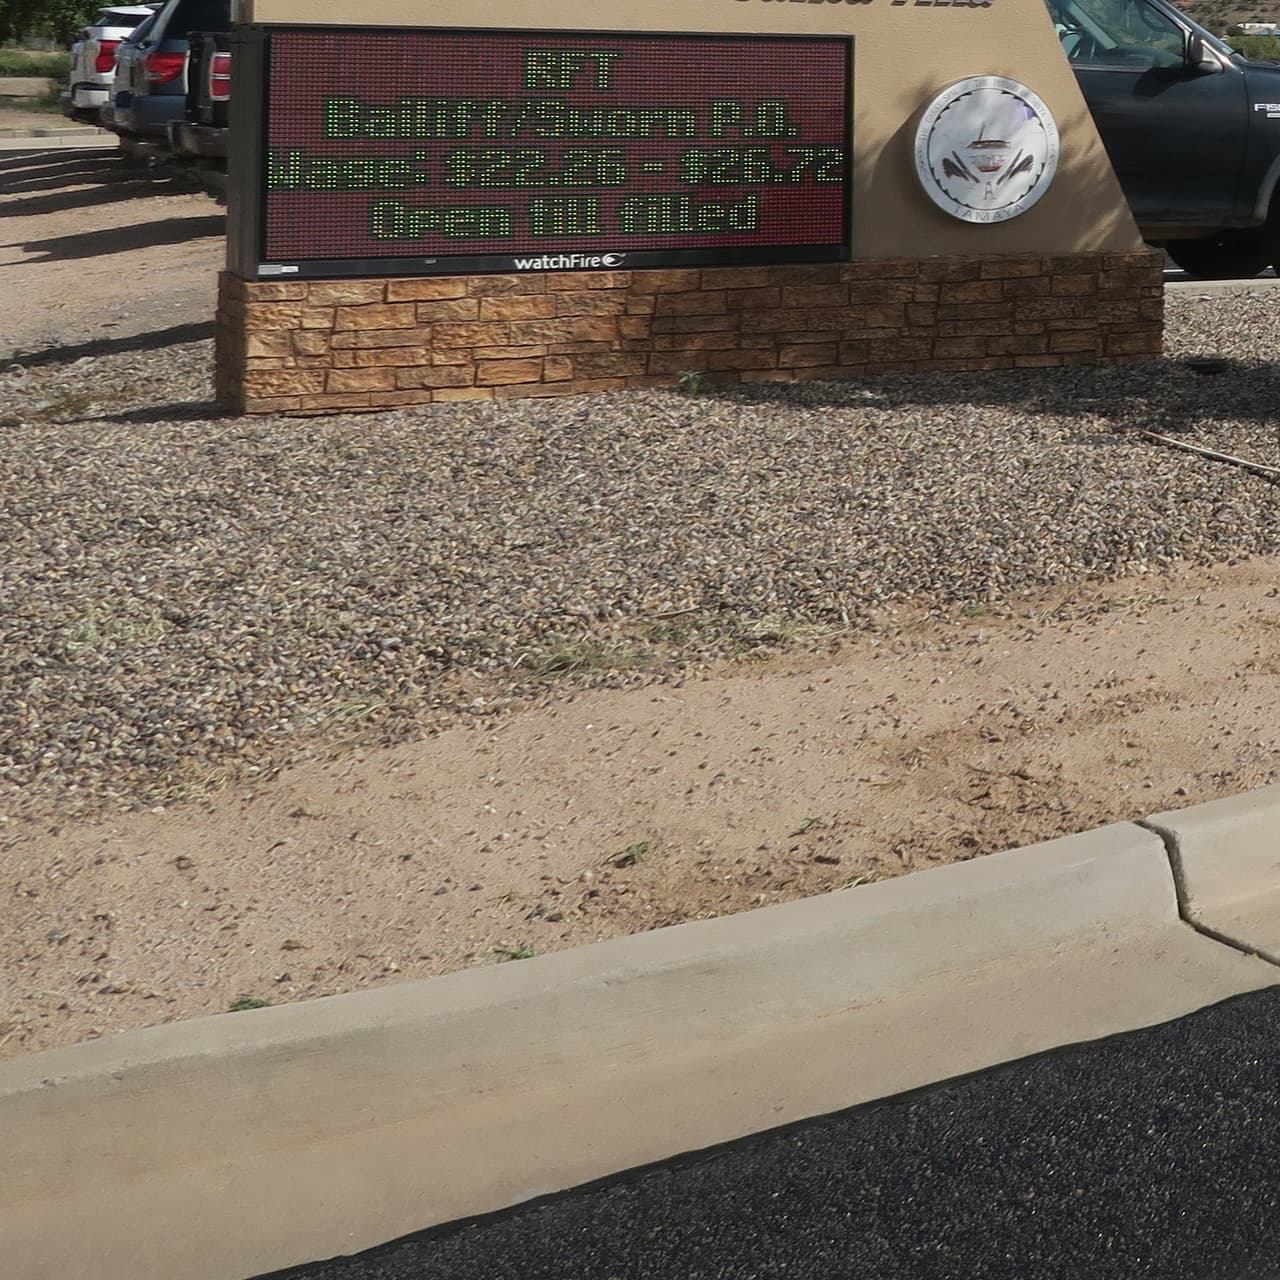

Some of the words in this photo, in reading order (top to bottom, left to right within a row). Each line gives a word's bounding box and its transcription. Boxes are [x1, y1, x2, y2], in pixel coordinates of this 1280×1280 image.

[527, 52, 619, 88] RFT
[327, 100, 696, 137] Bailiff/Sworn
[267, 150, 427, 188] Wage:
[445, 150, 626, 187] $22.26
[679, 148, 844, 184] $26.72
[372, 201, 511, 238] Open
[620, 196, 757, 232] filled
[953, 204, 1025, 221] TAMAYA
[514, 254, 601, 269] watchFire
